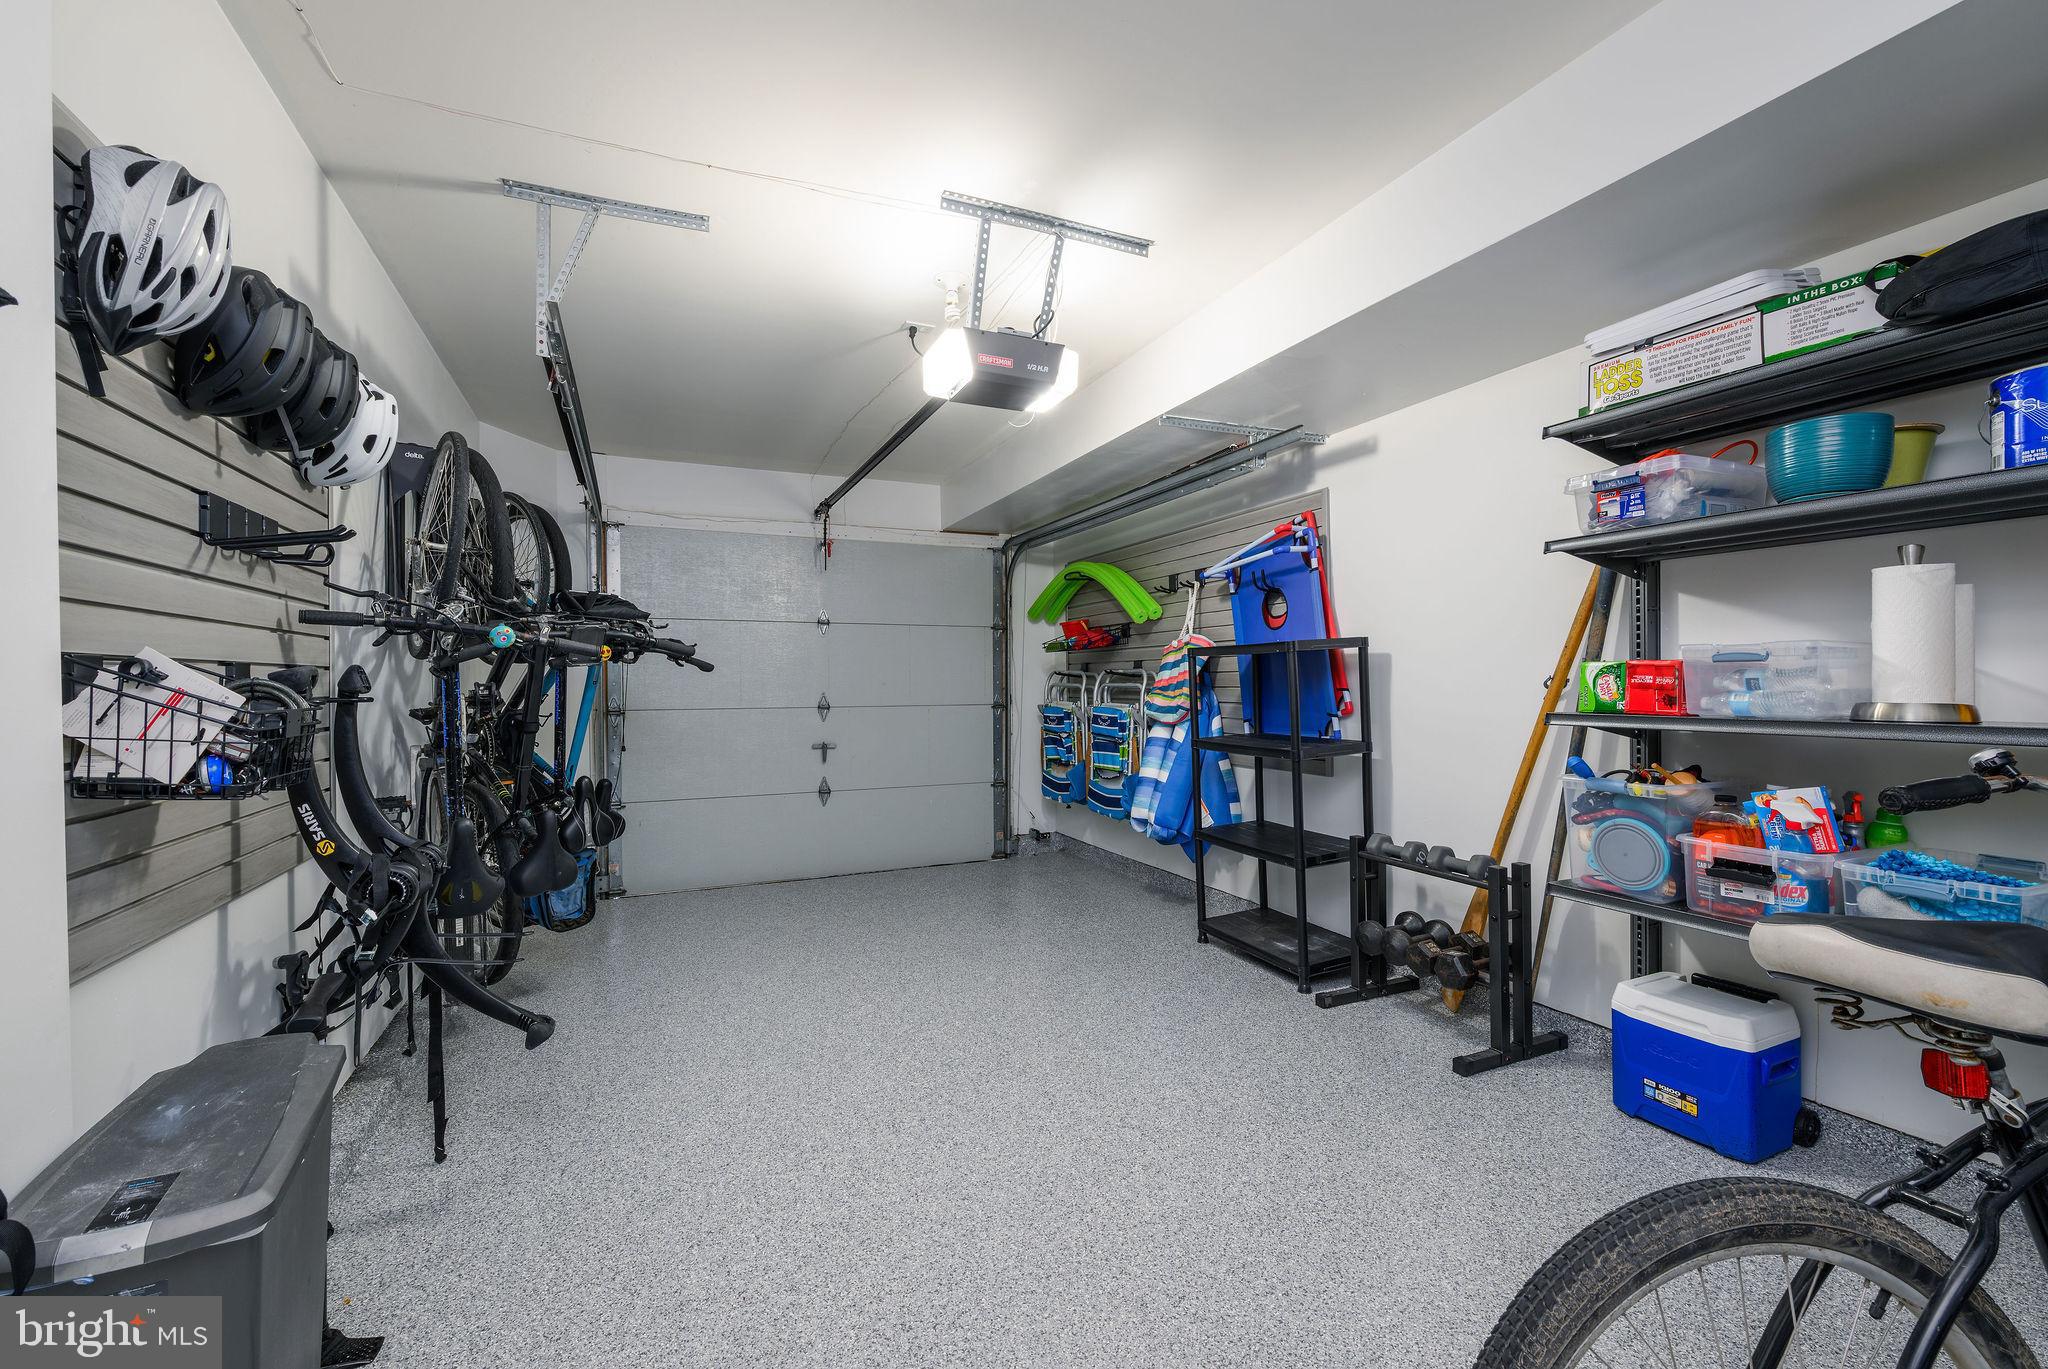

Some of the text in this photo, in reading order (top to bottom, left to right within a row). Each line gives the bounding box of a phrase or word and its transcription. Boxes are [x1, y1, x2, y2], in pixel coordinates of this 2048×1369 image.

[134, 223, 157, 266] GARNEAU
[1787, 276, 1862, 304] IN THE BOX:
[1653, 341, 1675, 352] THROWS
[1675, 337, 1686, 345] FOR
[1687, 330, 1710, 341] FRIENDS
[1717, 321, 1738, 332] FAMILY
[980, 355, 1012, 366] CRAFTSMAN
[1027, 363, 1037, 371] 1/2
[1593, 357, 1643, 384] LADDER
[1594, 369, 1643, 399] TOSS
[1598, 682, 1608, 698] DRY
[1600, 674, 1614, 702] CANADA
[297, 803, 326, 841] SARIS
[1416, 850, 1427, 865] 10
[1658, 1084, 1681, 1096] IGLOO
